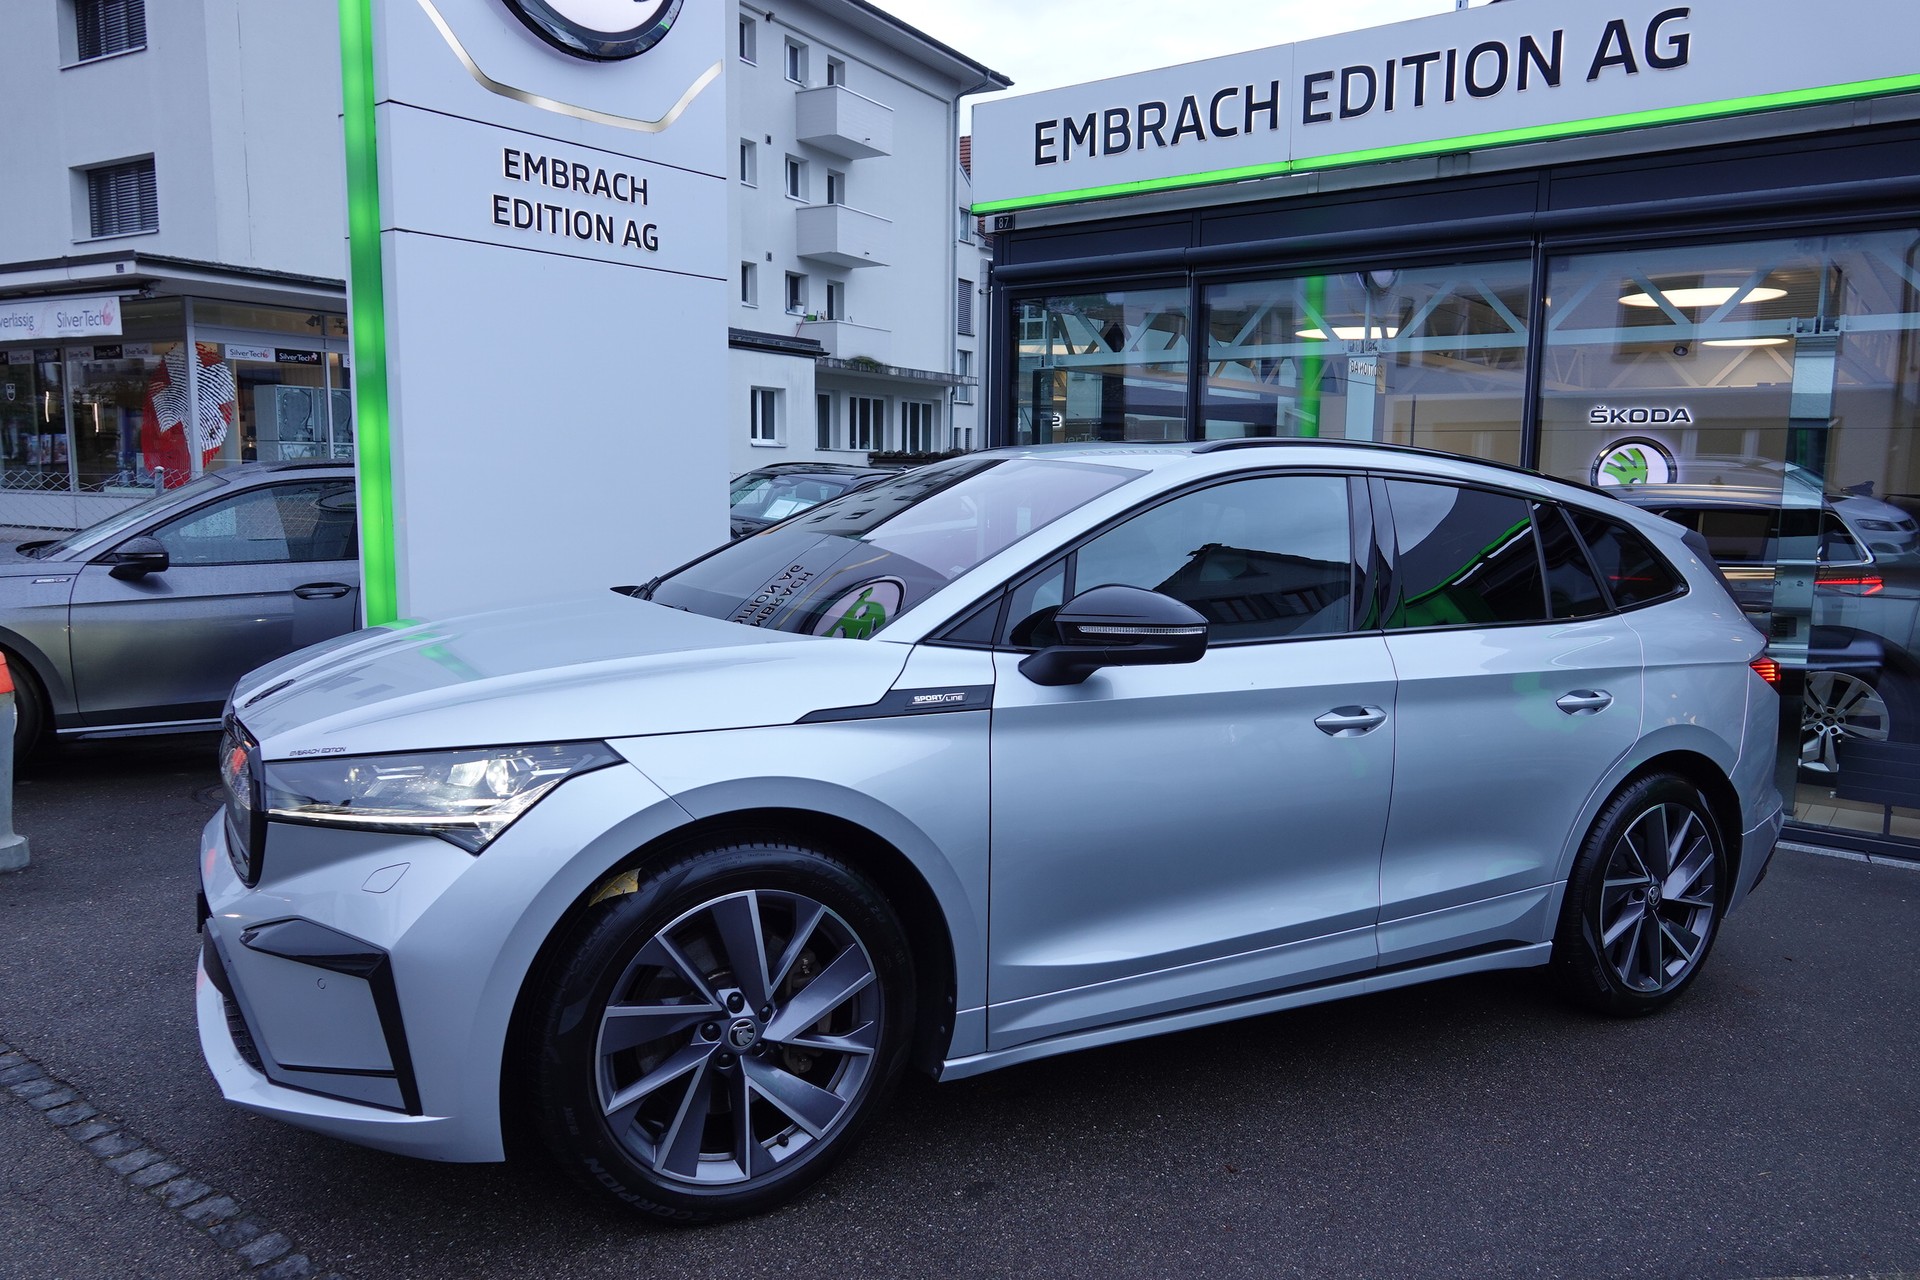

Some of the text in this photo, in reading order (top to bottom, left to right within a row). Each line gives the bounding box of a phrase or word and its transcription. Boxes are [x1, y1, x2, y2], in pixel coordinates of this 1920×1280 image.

[1034, 7, 1690, 166] EMBRACH EDITION AG
[503, 147, 648, 206] EMBRACH
[492, 194, 659, 252] EDITION AG
[998, 217, 1009, 229] 87
[56, 309, 106, 328] SilverTech
[1590, 405, 1691, 424] ŠKODA
